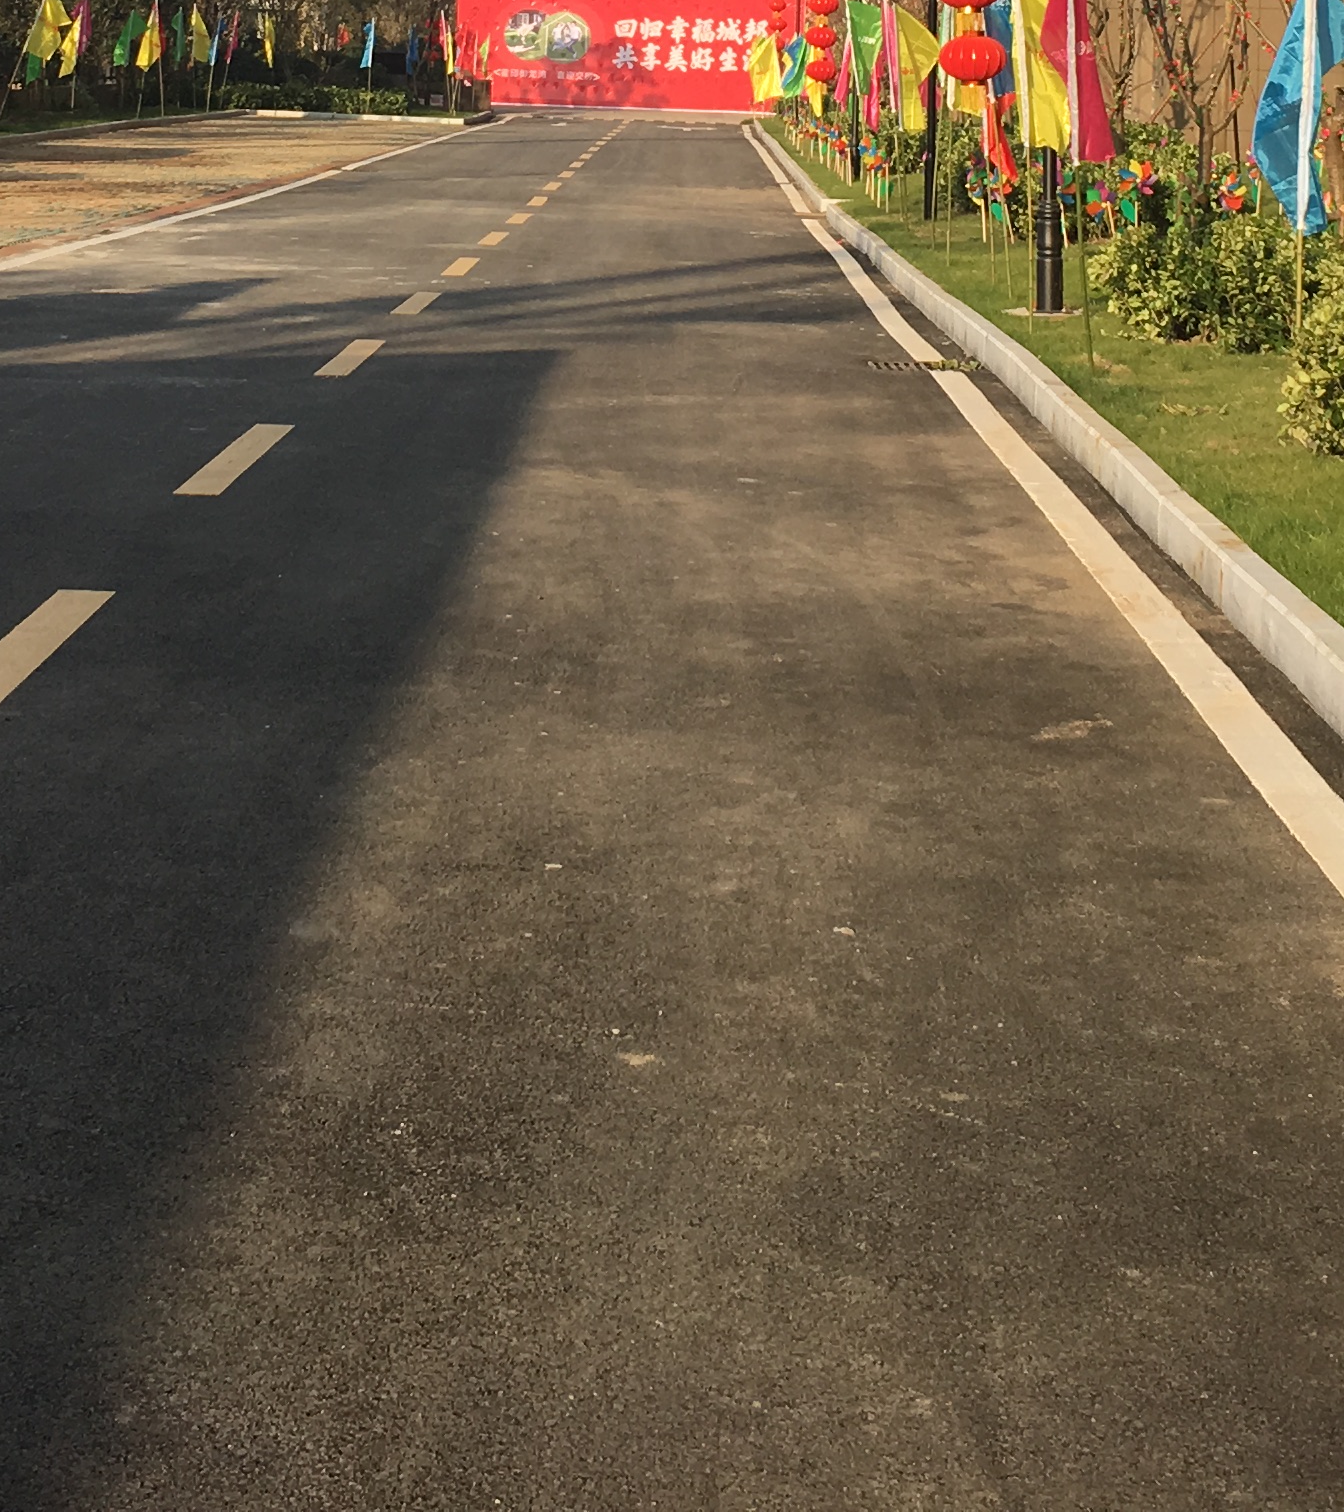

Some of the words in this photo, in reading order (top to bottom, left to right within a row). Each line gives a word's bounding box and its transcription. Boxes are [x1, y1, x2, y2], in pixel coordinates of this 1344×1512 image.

[614, 16, 769, 45] 回归幸福城邦
